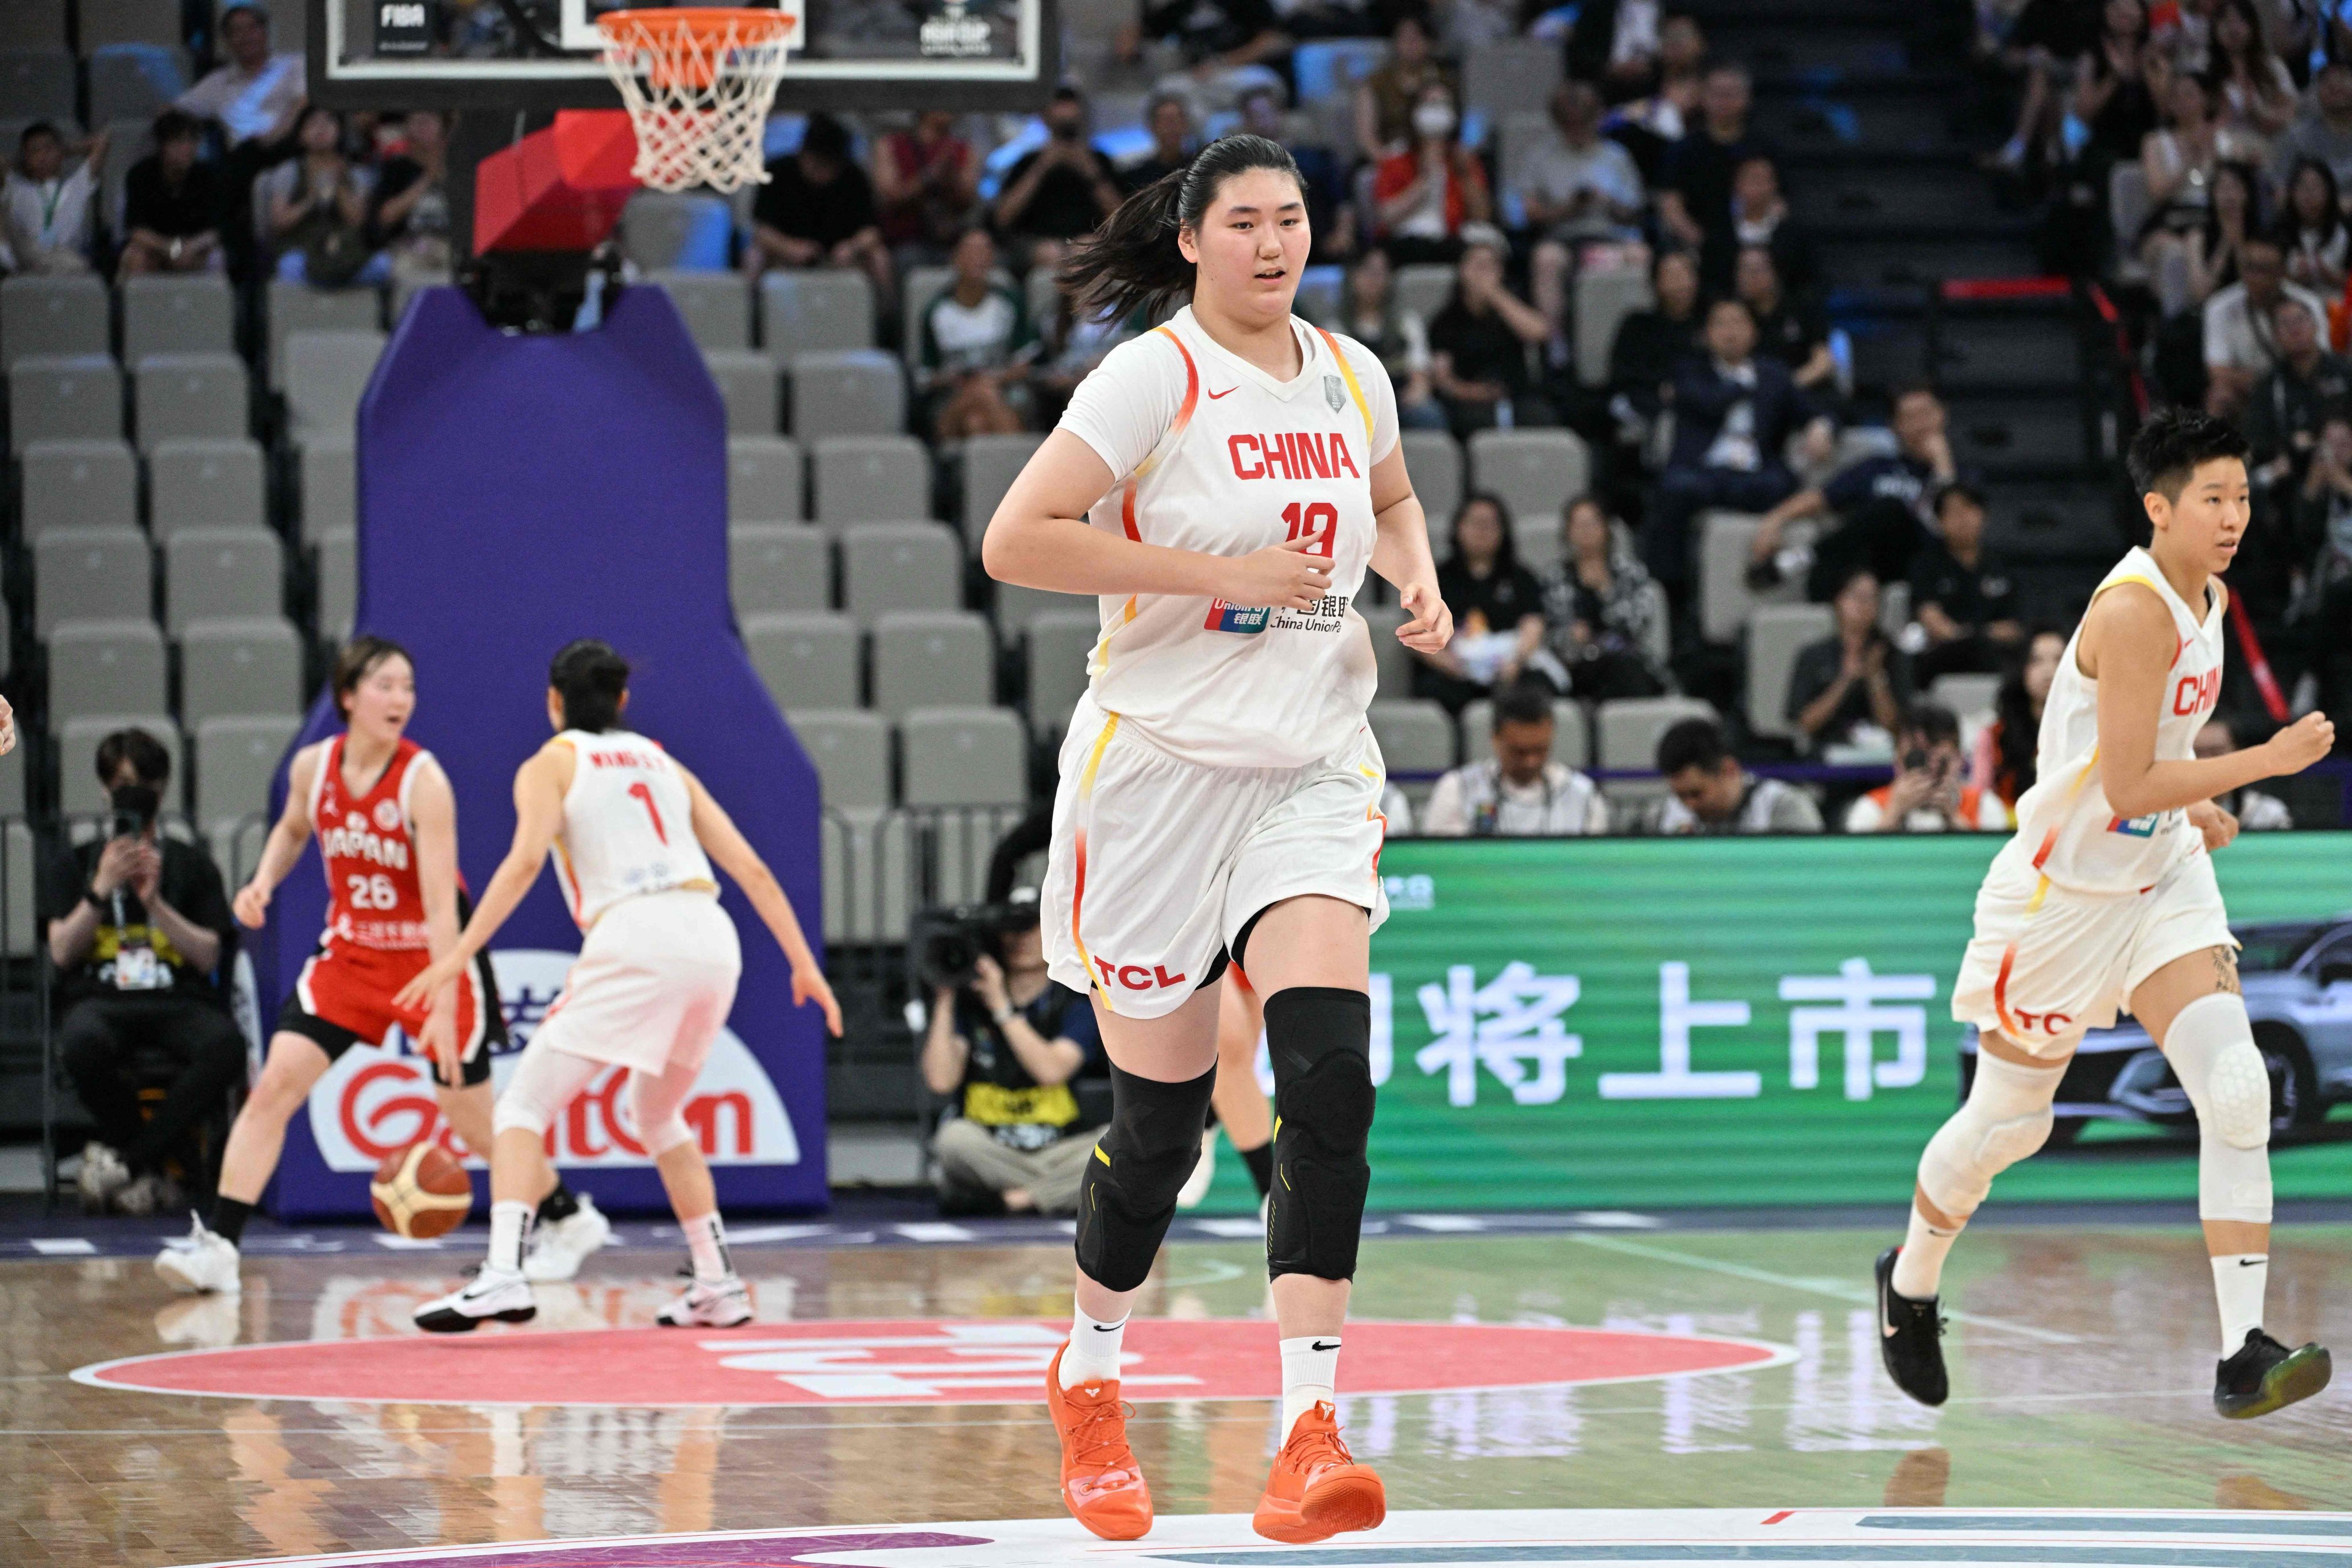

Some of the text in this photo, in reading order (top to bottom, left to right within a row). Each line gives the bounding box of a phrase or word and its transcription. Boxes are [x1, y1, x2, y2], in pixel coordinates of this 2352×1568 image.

[380, 3, 425, 28] FIBA
[1227, 432, 1360, 480] CHINA
[1234, 613, 1263, 625] 银联
[2173, 664, 2220, 716] CHIN
[628, 783, 669, 846] 1
[323, 827, 408, 871] JAPAN
[347, 874, 398, 910] 26
[1094, 955, 1186, 990] TCL
[2014, 1008, 2073, 1036] TC
